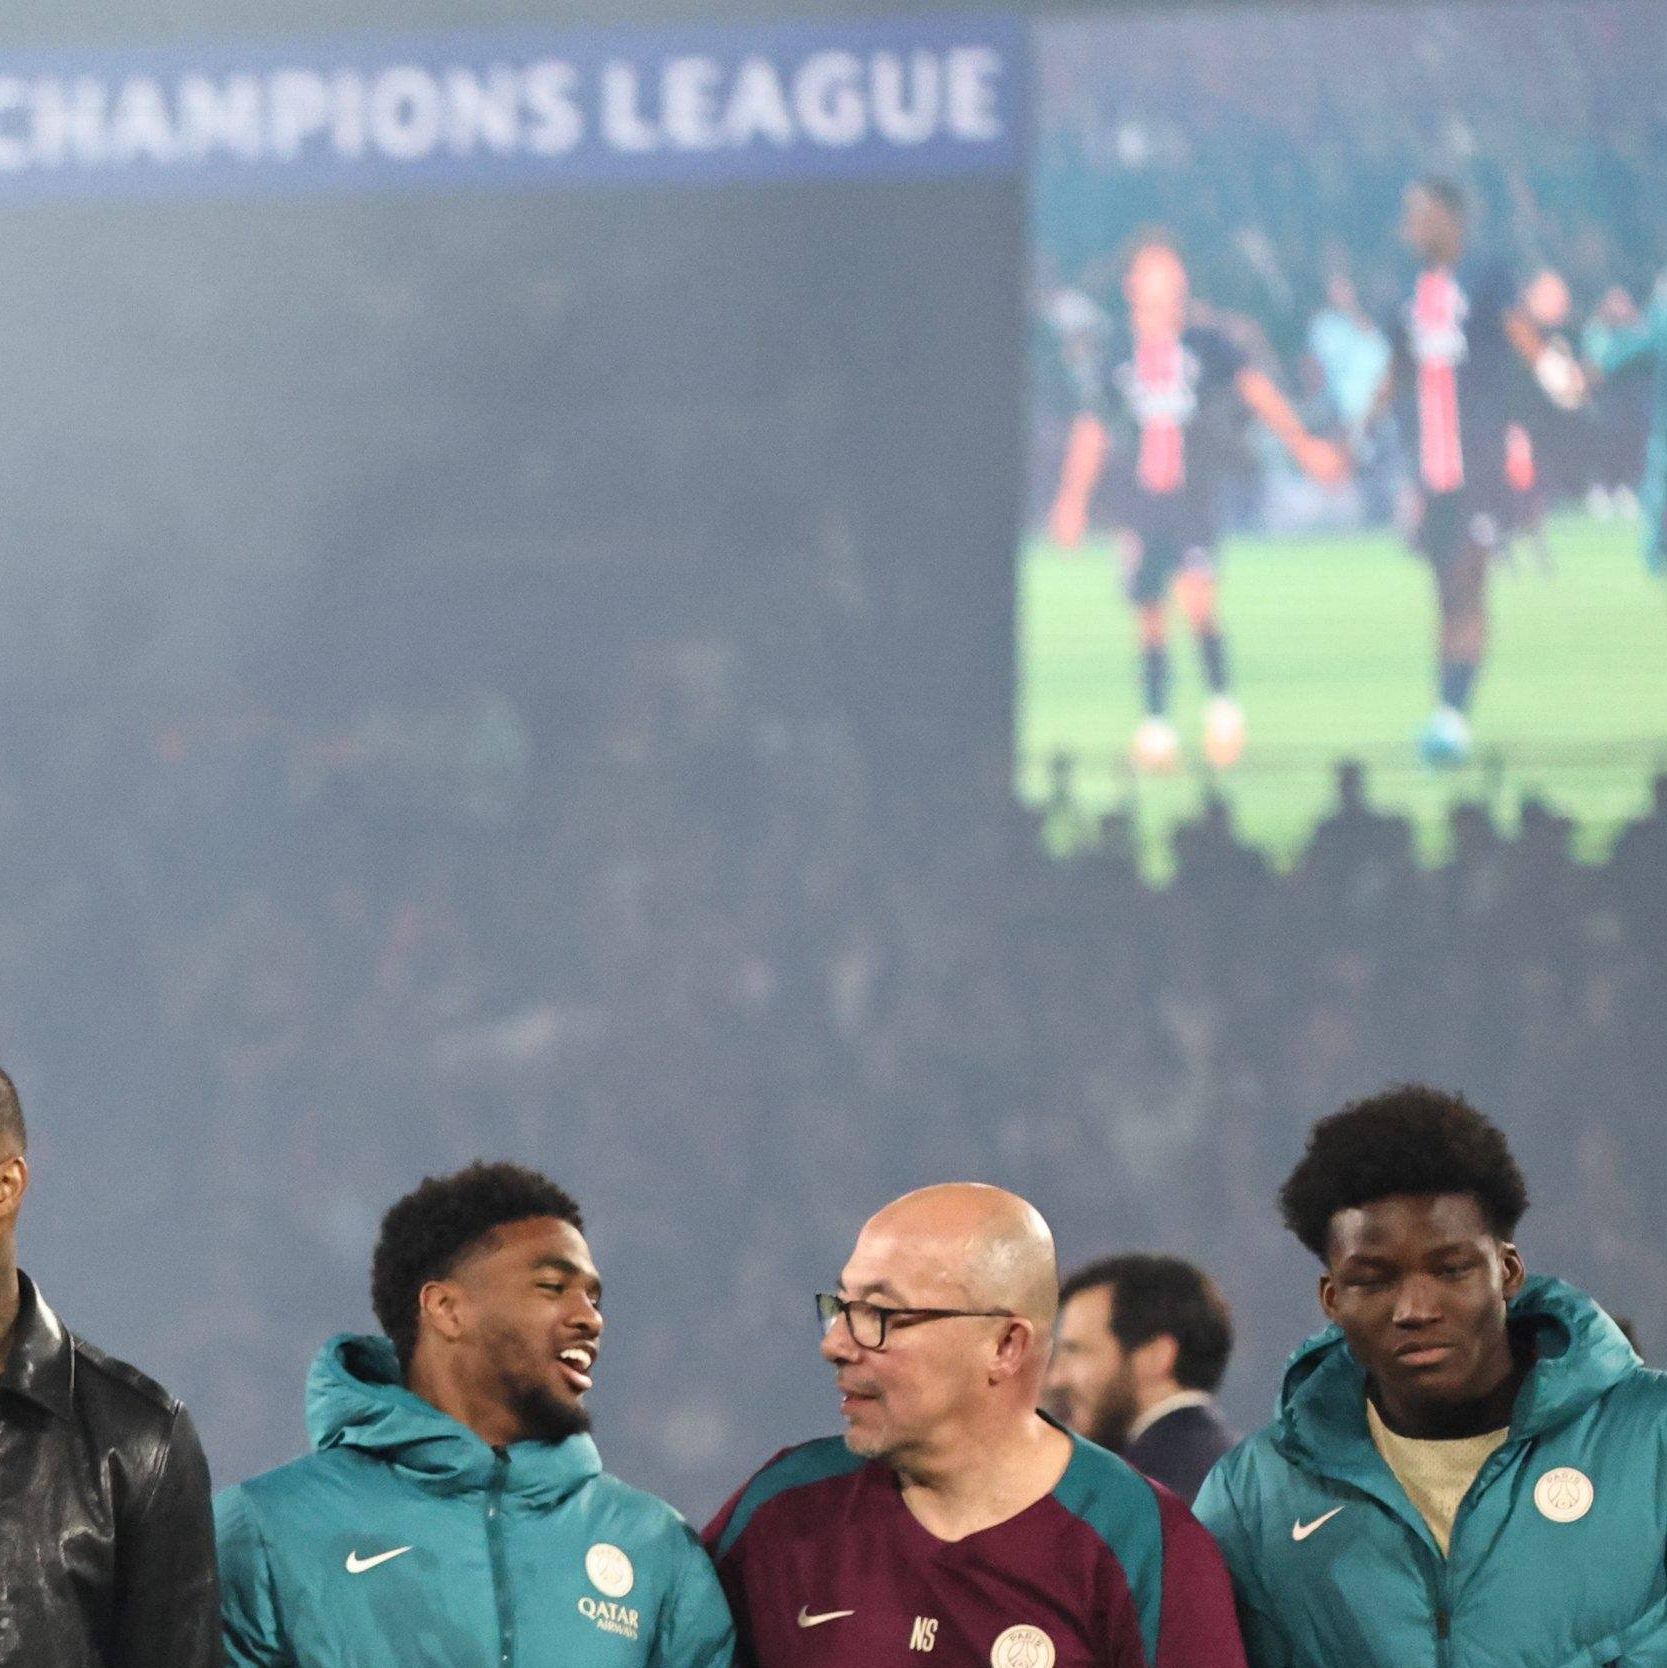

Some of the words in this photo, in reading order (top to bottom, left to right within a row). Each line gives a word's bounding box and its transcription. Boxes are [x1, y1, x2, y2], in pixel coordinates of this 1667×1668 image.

[603, 48, 1003, 152] LEAGUE
[578, 1596, 639, 1628] QATAR
[909, 1616, 939, 1654] NS
